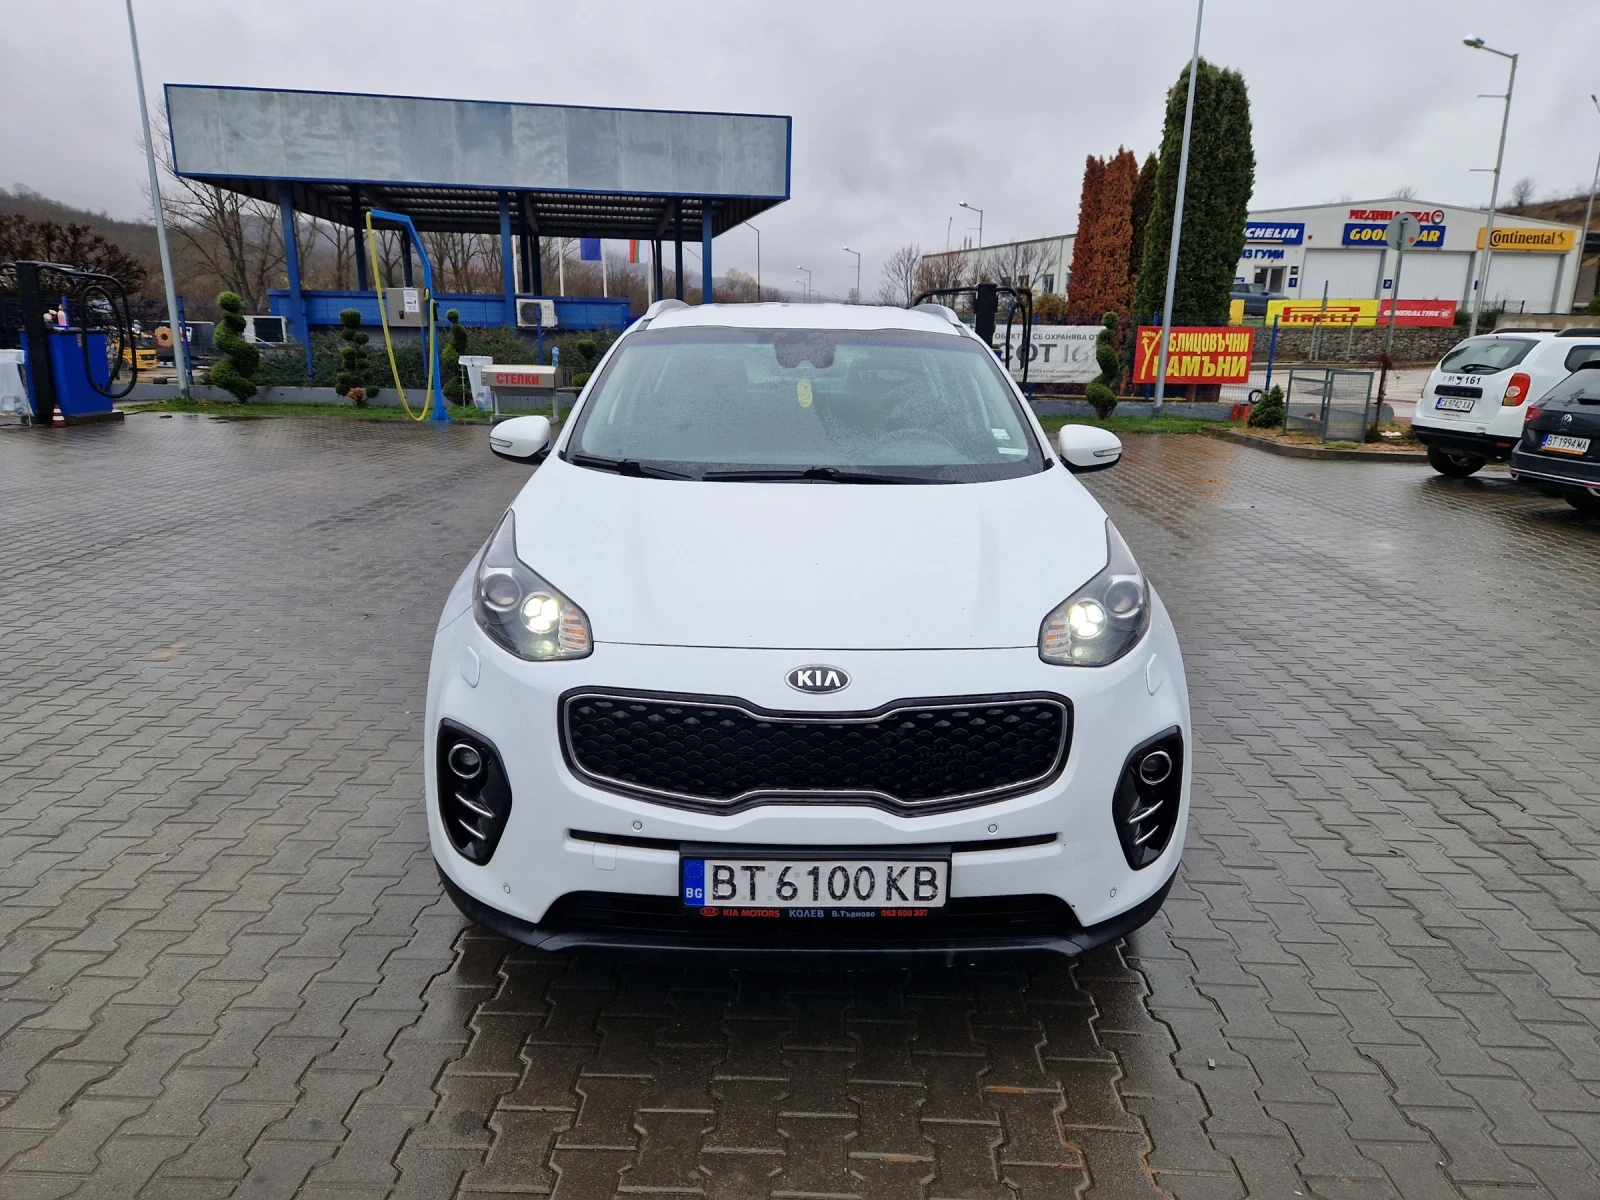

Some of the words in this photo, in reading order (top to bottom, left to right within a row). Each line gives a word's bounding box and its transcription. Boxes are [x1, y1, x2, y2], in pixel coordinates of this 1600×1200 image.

[1349, 210, 1400, 221] МЕДИН
[1242, 227, 1299, 238] CHELIN
[1350, 229, 1440, 241] GOOAR
[1490, 229, 1556, 247] Continental
[1254, 249, 1285, 259] ГУМИ
[1282, 307, 1361, 322] PIRELLI
[1045, 333, 1087, 341] ОХРАНЯВА
[1168, 333, 1249, 354] БЛИЦОВЪЧНИ
[496, 373, 539, 385] СТЕЛКИ
[1465, 376, 1481, 385] 161
[1547, 435, 1558, 446] BT
[1558, 437, 1577, 449] 1994
[797, 670, 841, 687] KIA
[685, 888, 703, 898] BG
[712, 865, 766, 901] BT
[776, 865, 876, 901] 6100
[885, 865, 939, 901] KB
[722, 909, 739, 917] KIA
[741, 909, 780, 918] MOTORS
[788, 909, 825, 918] КОЛЕВ
[832, 910, 876, 918] В.Търново
[881, 909, 896, 917] 062
[897, 909, 913, 917] 600
[913, 909, 928, 917] 397
